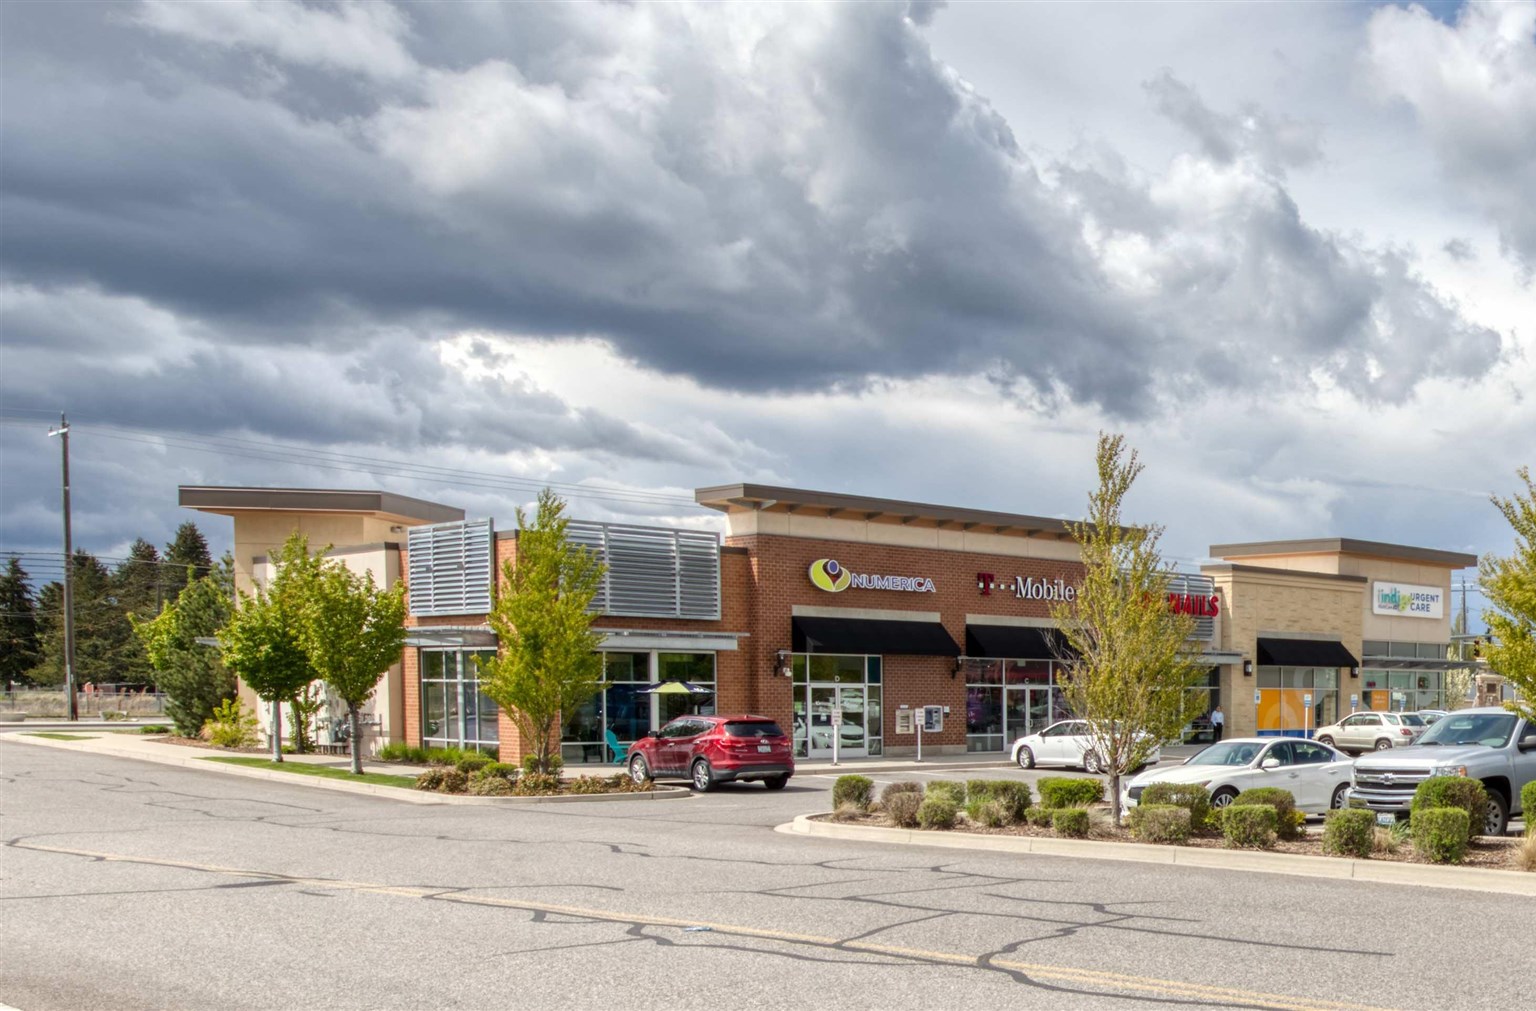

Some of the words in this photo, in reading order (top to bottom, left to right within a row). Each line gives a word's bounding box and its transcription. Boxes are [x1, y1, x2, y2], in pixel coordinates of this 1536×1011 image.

[851, 573, 936, 592] NUMERICA
[1169, 592, 1219, 617] NAILS
[1410, 593, 1439, 603] URGENT
[1410, 602, 1430, 612] CARE
